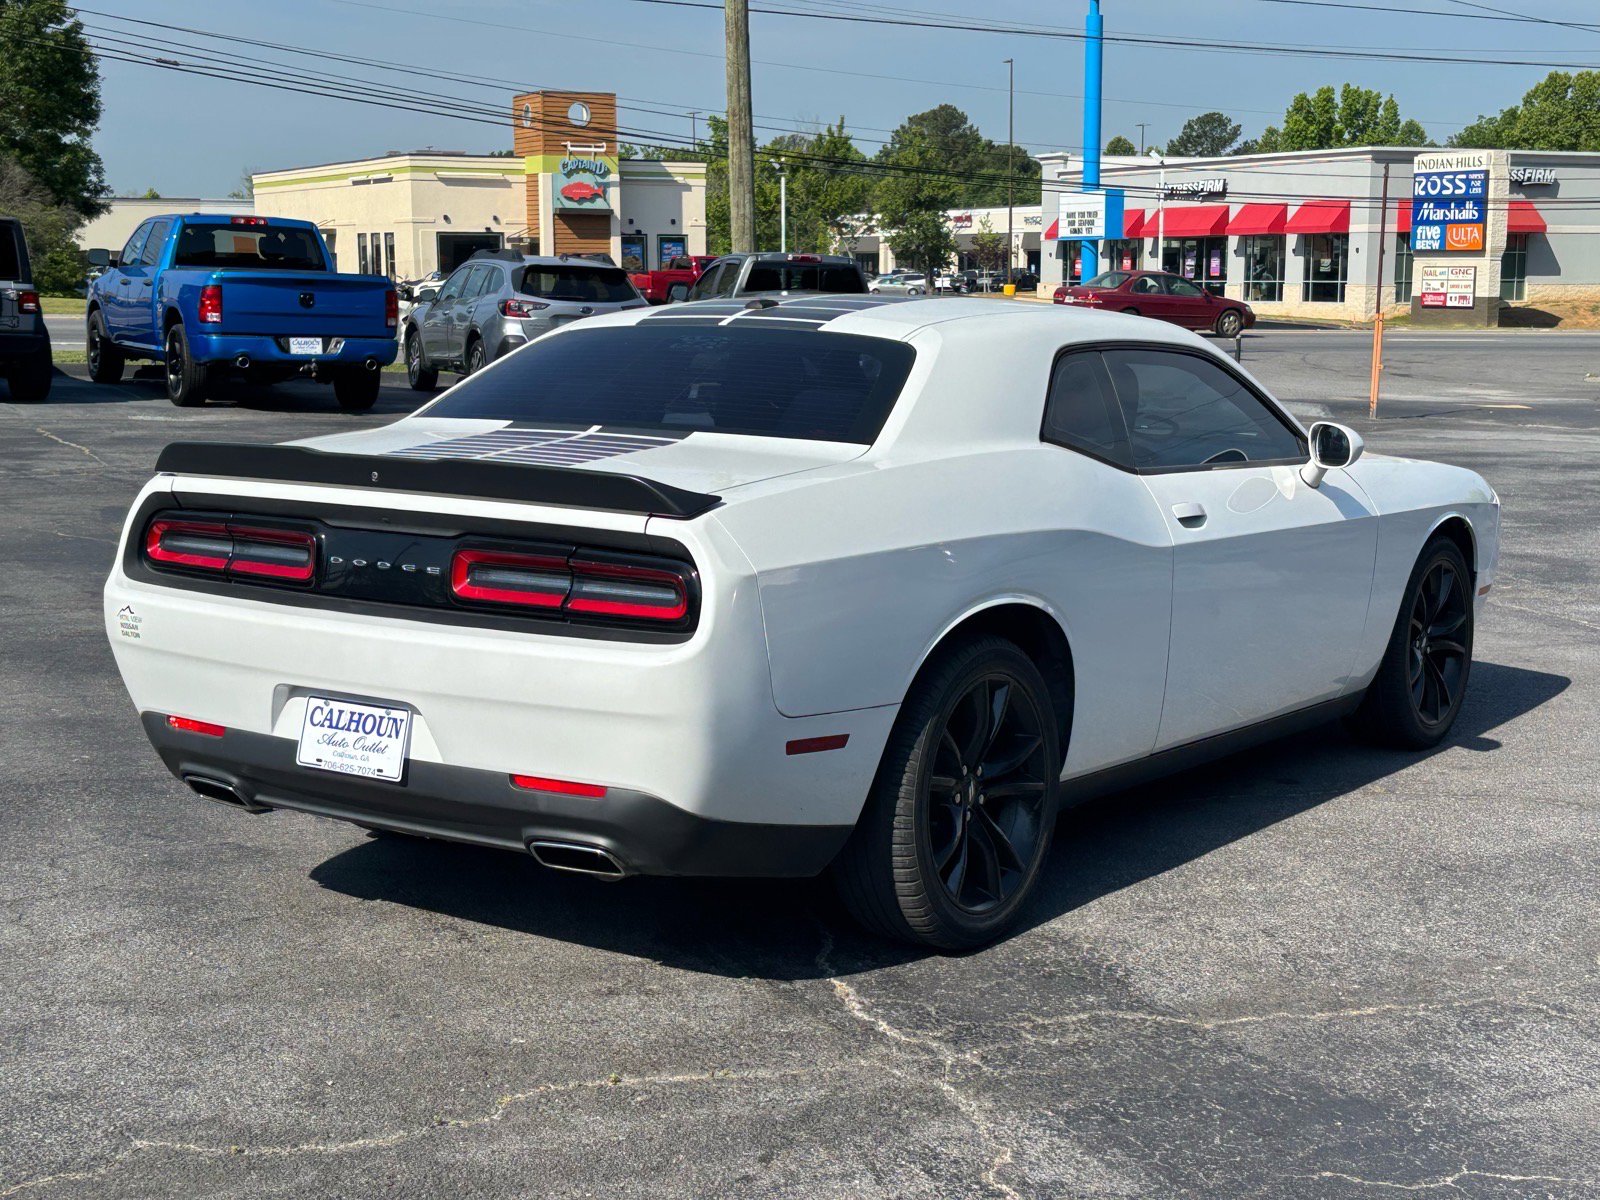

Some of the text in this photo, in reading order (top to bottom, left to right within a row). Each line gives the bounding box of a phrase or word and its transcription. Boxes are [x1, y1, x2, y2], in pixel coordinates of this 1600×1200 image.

[1418, 156, 1483, 170] INDIAN HILLS
[1415, 174, 1467, 196] ROSS
[1417, 201, 1479, 220] Marshalls
[1417, 226, 1441, 240] five
[1453, 227, 1480, 241] ULTA
[1416, 240, 1440, 250] BELOW
[330, 556, 440, 574] DODGE
[120, 622, 139, 630] NISSAN
[121, 630, 140, 638] DALTON
[309, 705, 404, 740] CALHOUN
[317, 732, 389, 755] Auto Outlet
[323, 760, 376, 776] 706-625-7074
